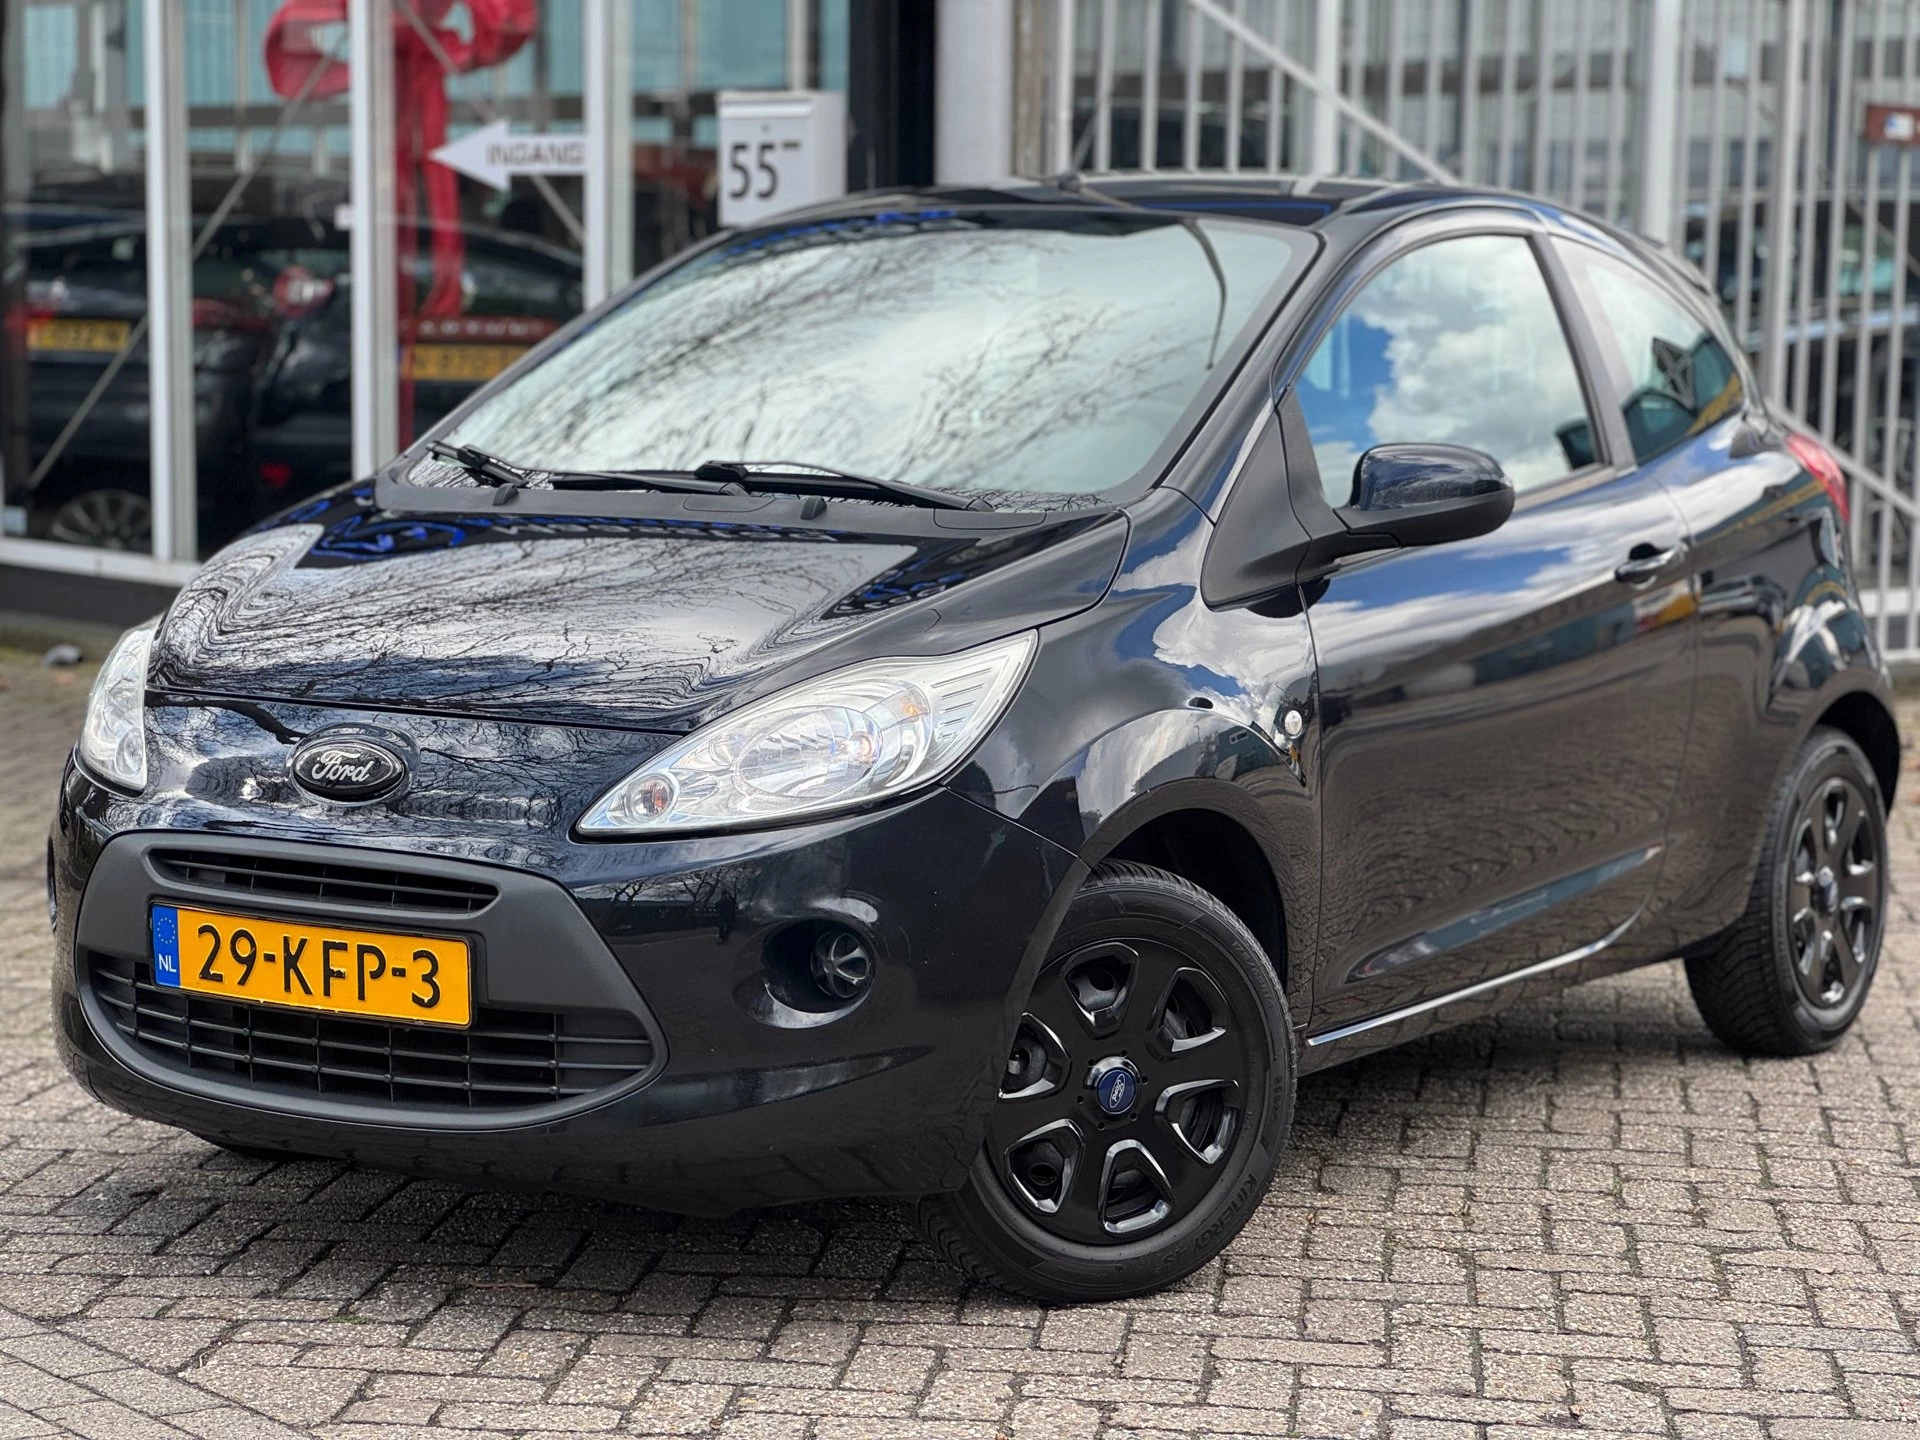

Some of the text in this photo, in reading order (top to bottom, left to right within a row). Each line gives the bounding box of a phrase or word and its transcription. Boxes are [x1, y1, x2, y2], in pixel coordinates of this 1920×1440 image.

[486, 142, 584, 168] INGANG
[312, 750, 374, 782] Ford
[158, 953, 177, 974] NL
[197, 924, 441, 1009] 29-KFP-3
[1111, 1079, 1124, 1102] Ford
